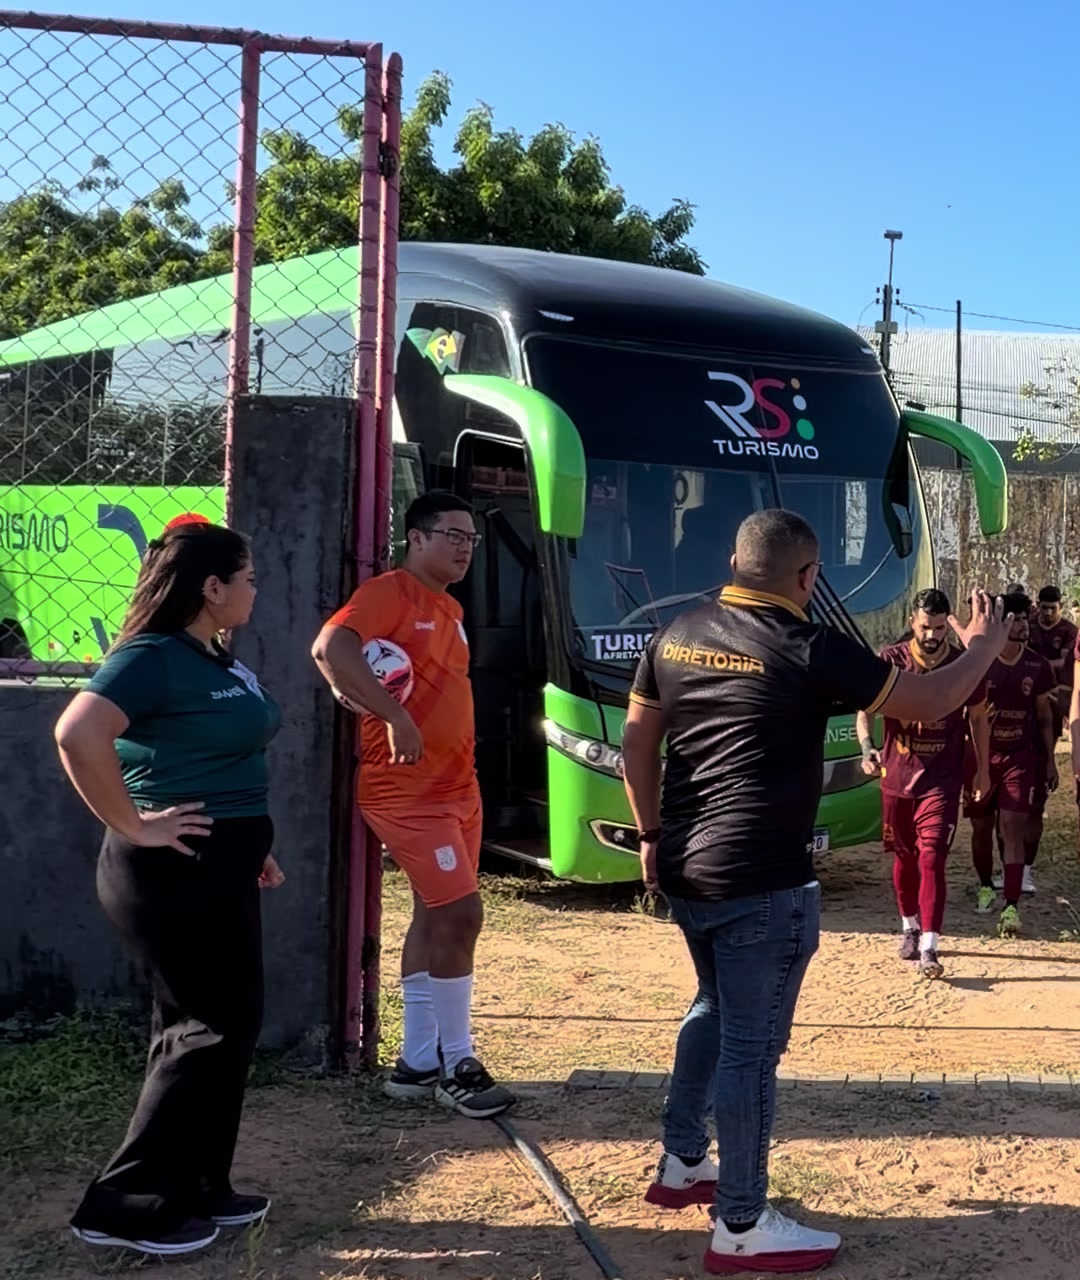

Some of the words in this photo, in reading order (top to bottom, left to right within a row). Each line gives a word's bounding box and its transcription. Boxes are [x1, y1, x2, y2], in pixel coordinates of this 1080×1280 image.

[704, 371, 791, 438] RS
[713, 439, 819, 460] TURISMO
[662, 644, 766, 673] DIRETORIA
[946, 823, 955, 846] 7
